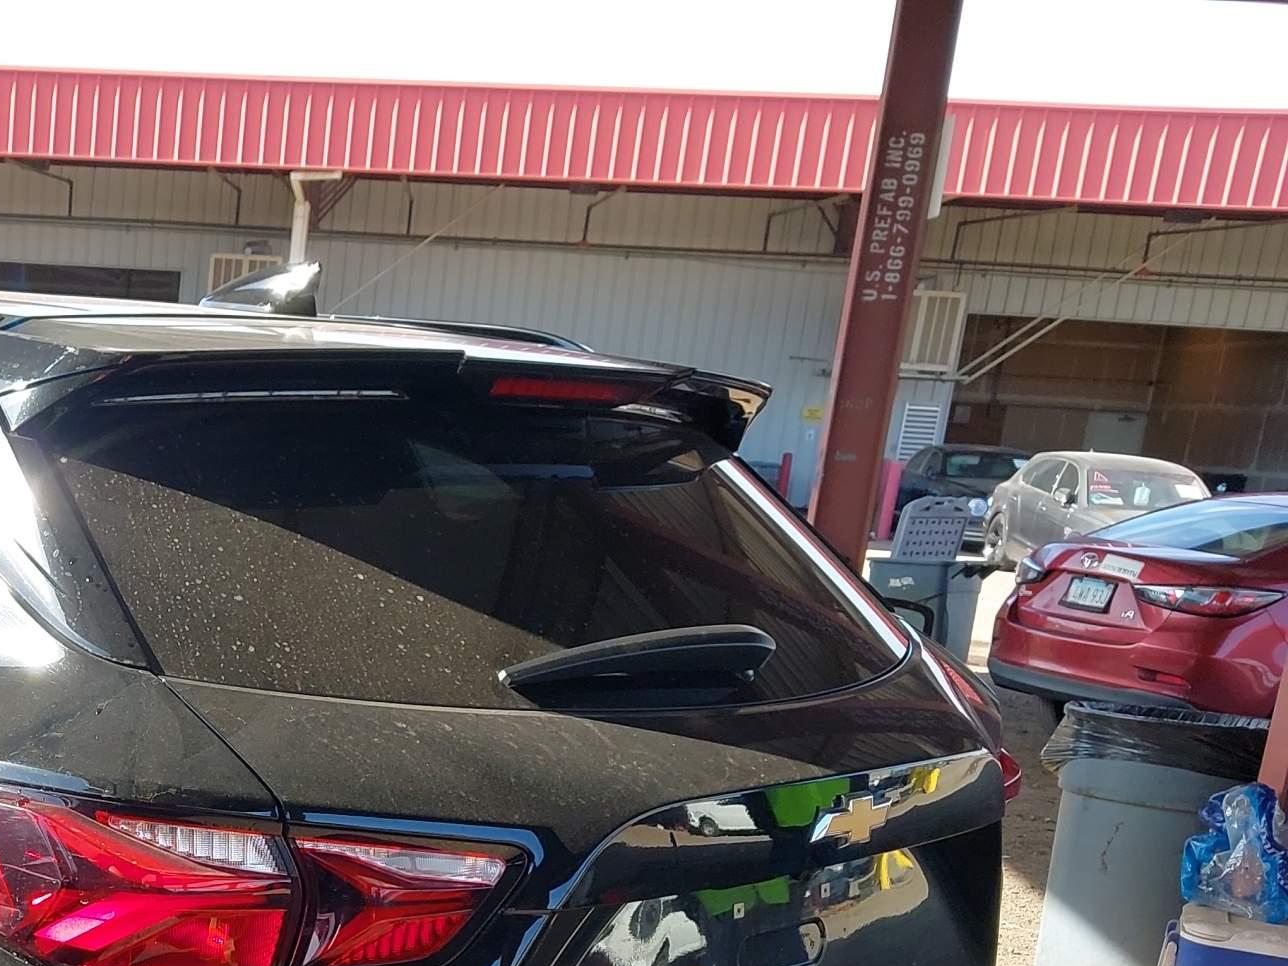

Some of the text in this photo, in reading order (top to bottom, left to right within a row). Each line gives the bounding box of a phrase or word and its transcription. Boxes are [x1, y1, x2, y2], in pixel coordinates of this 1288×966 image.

[862, 130, 908, 302] U.S. PREFAB INC.
